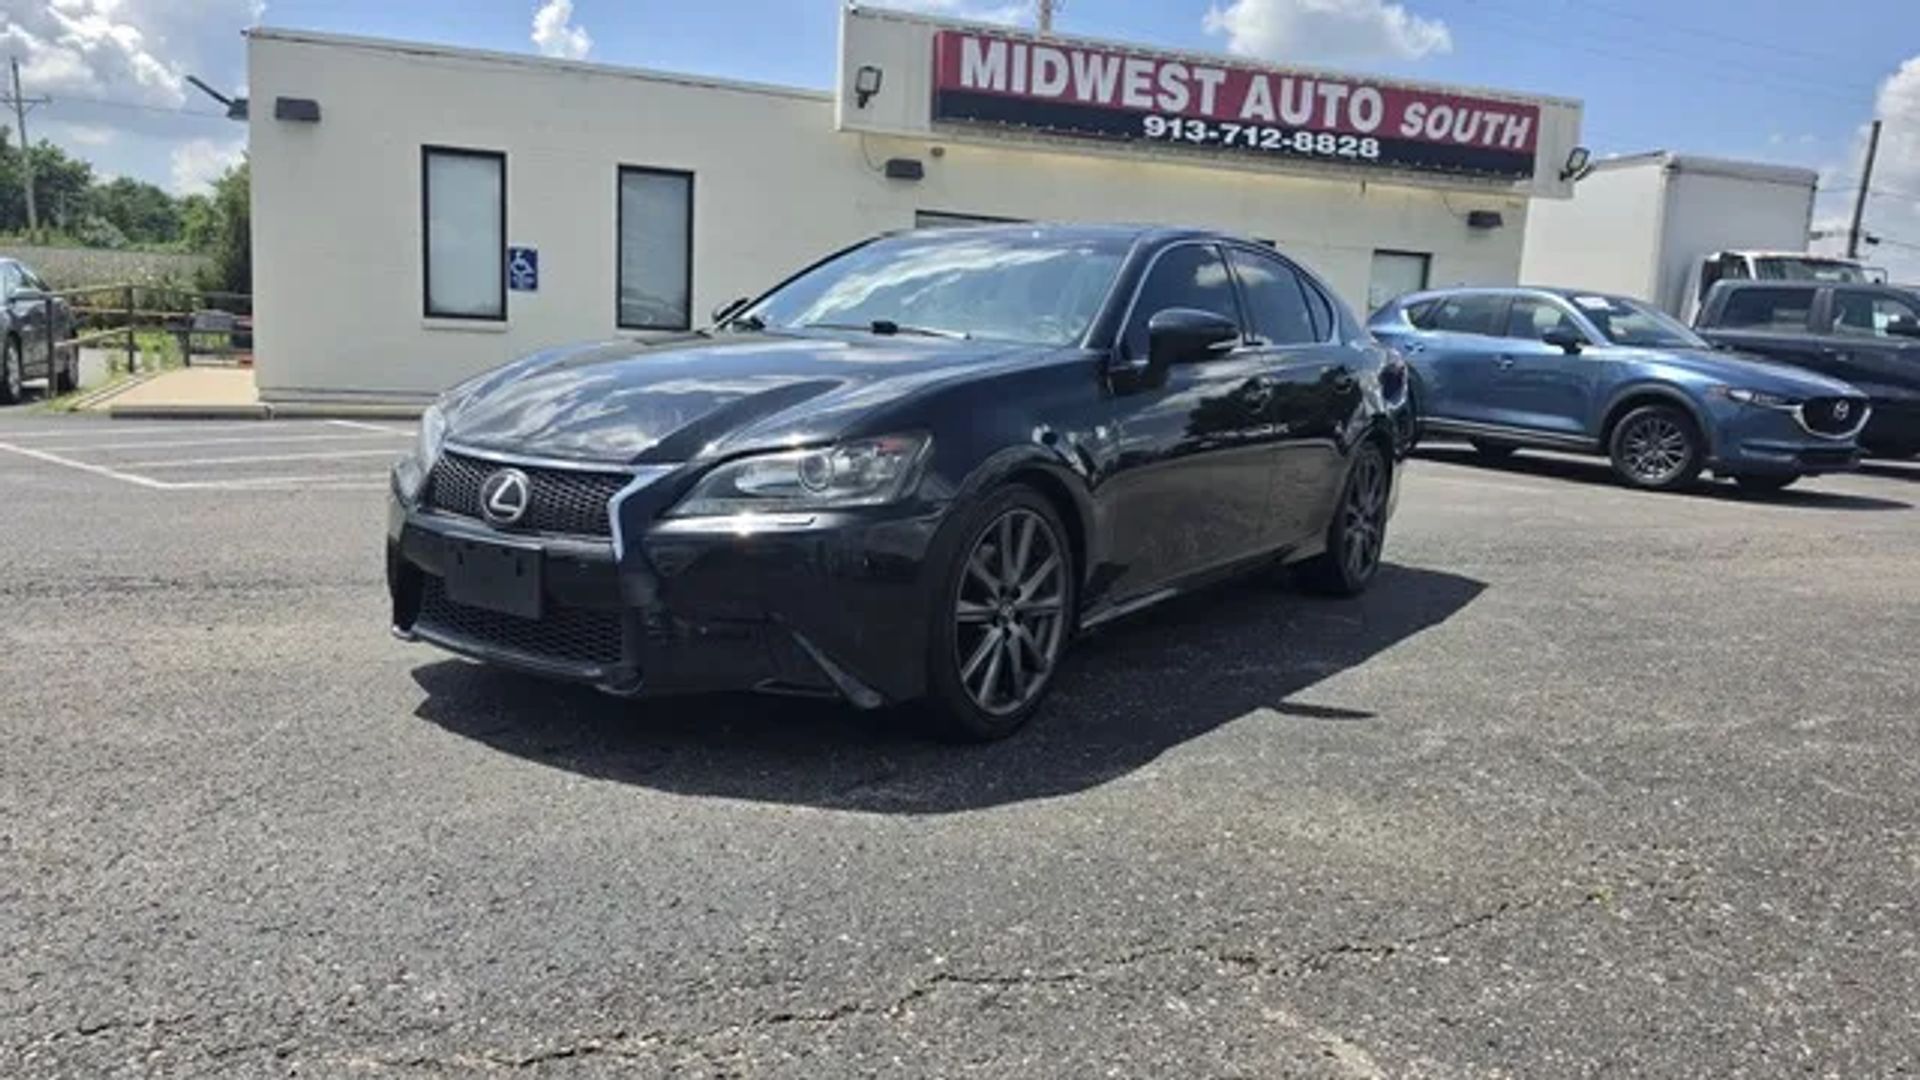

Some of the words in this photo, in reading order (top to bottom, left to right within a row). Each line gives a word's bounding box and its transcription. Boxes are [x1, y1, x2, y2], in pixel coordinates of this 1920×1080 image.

[960, 36, 1226, 115] MIDWEST
[1240, 75, 1384, 133] AUTO
[1400, 102, 1531, 149] SOUTH
[1143, 116, 1380, 158] 913-712-8828
